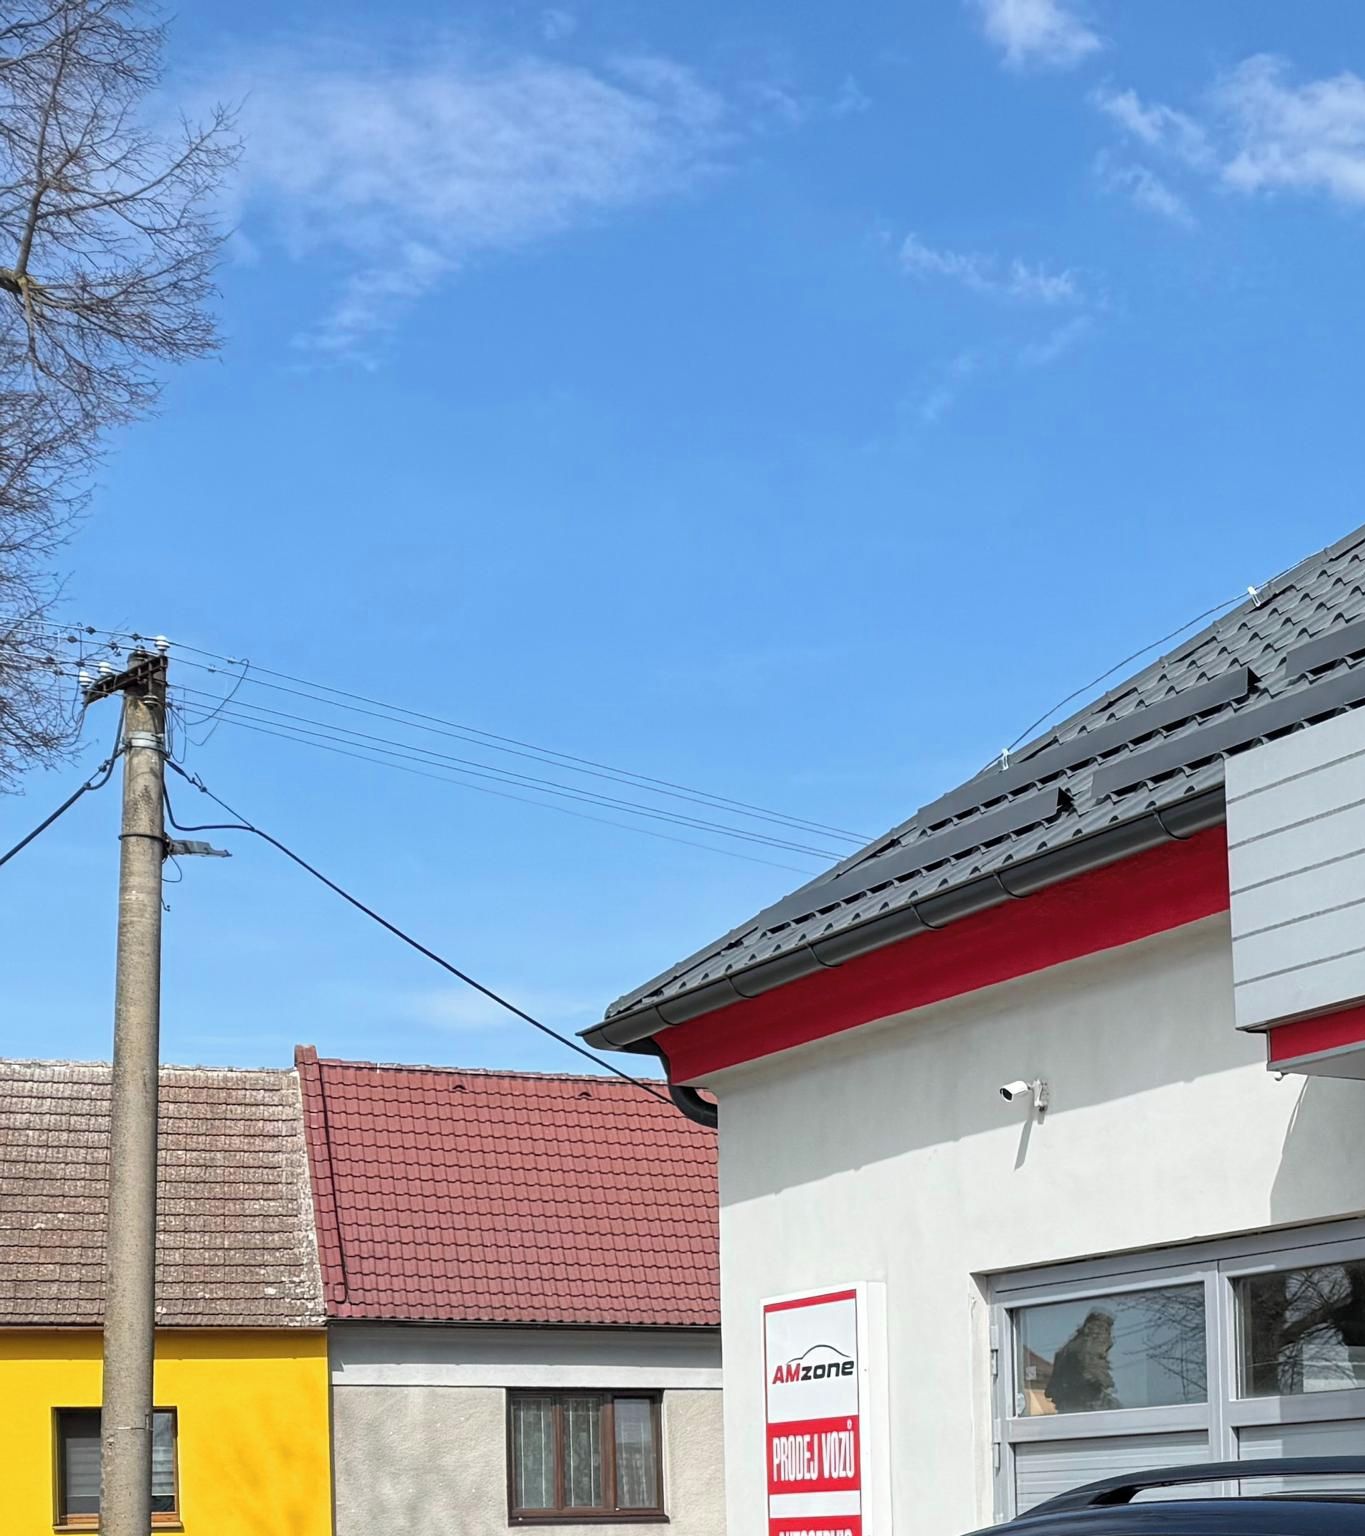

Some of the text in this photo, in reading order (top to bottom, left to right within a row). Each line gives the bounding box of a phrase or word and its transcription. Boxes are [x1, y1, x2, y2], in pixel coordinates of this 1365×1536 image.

[772, 1360, 855, 1384] AMzone
[772, 1419, 855, 1482] PRODEJ VOZŮ
